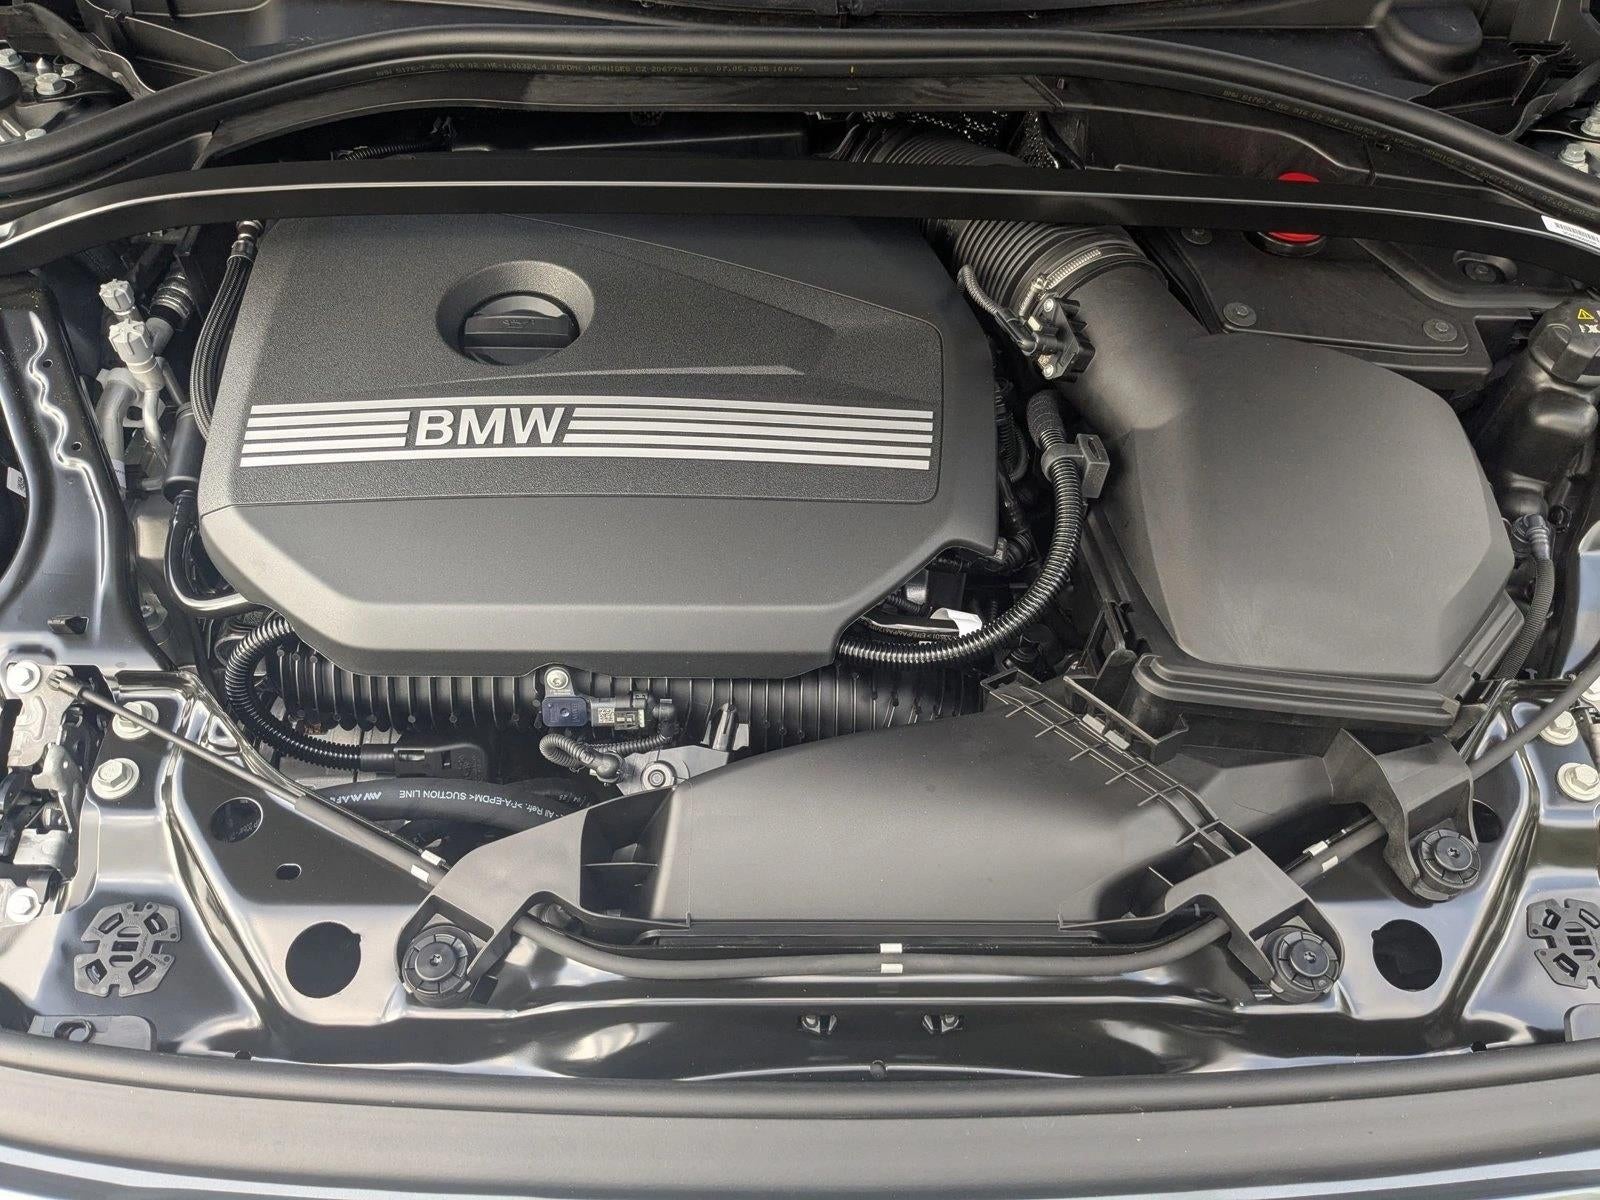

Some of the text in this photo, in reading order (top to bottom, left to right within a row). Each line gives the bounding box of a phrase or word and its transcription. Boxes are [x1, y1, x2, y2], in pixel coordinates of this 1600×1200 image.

[415, 407, 565, 446] BMW
[399, 789, 421, 799] LINE
[423, 790, 467, 801] SUCTION
